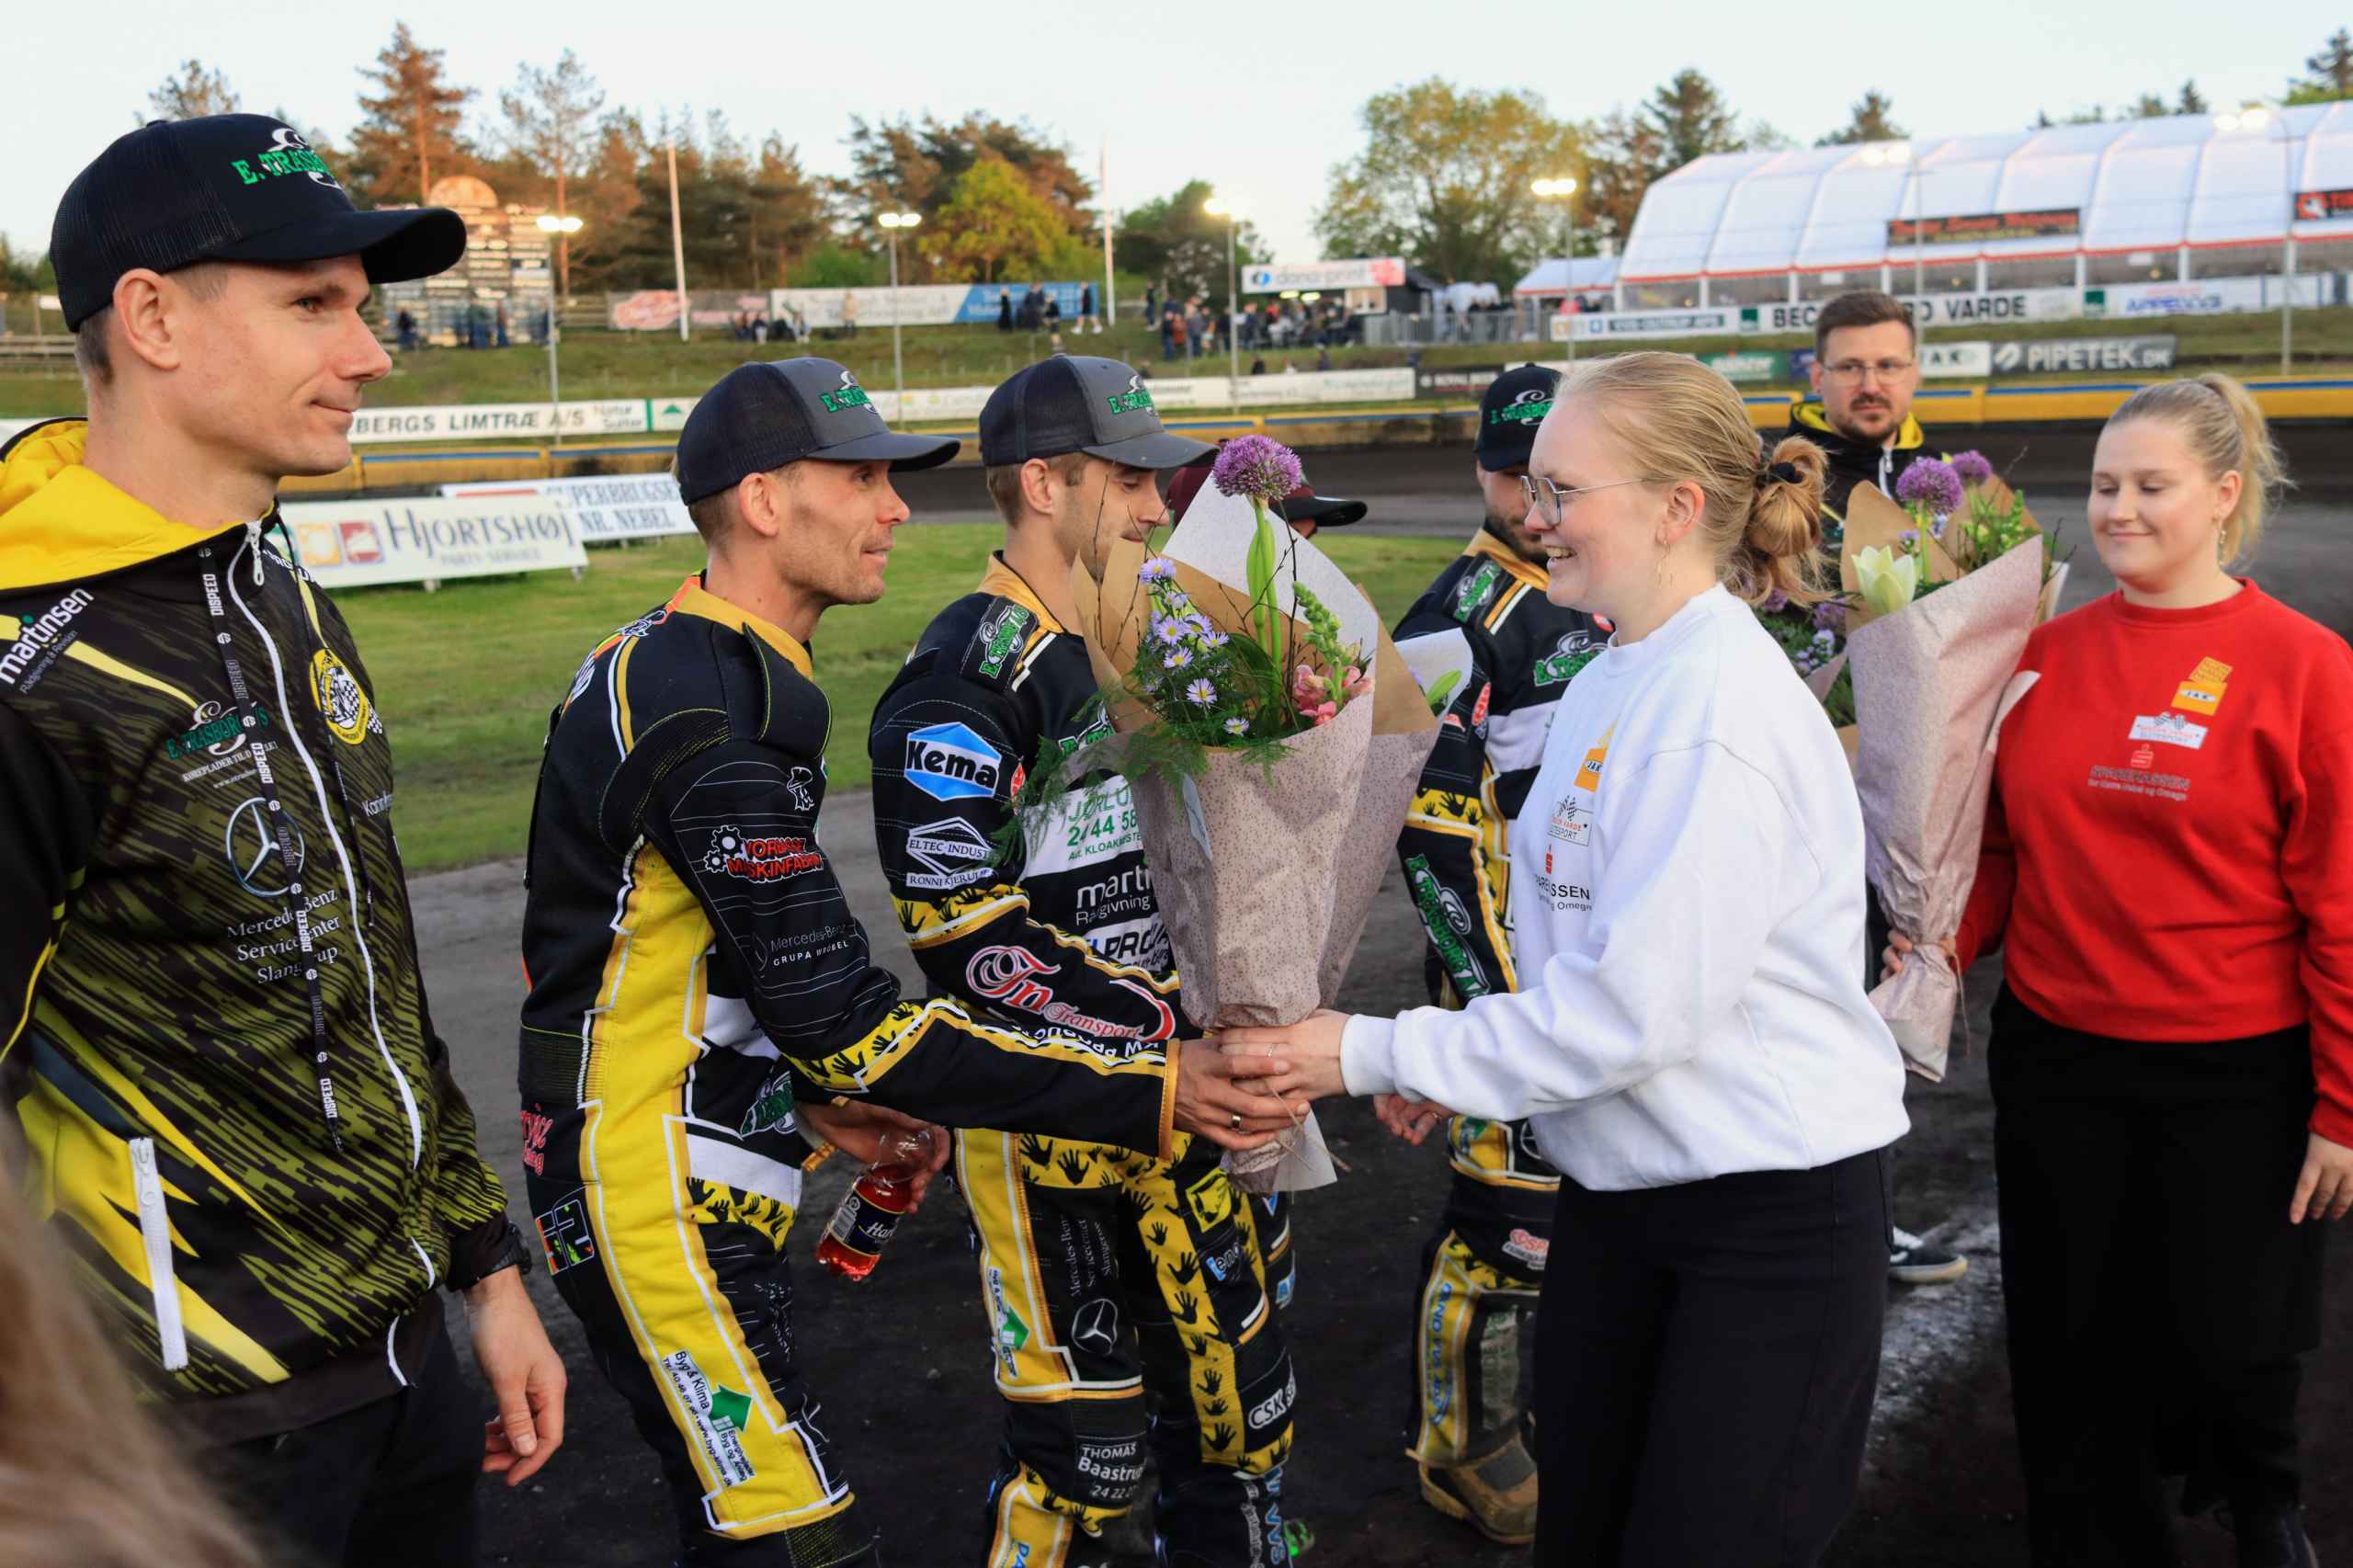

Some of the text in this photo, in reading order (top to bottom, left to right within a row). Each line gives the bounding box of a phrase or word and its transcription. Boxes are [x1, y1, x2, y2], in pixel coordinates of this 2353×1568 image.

[355, 415, 437, 434] BERGS
[203, 574, 224, 616] DISPEED
[0, 588, 95, 685] martinsen
[250, 743, 274, 784] DISPEED
[906, 741, 998, 790] Kema
[949, 844, 992, 858] INDUST
[1086, 832, 1142, 856] KLOAKMESTE
[297, 910, 313, 952] DISPEED
[773, 950, 813, 966] GRUPA
[1042, 1001, 1145, 1040] Transport
[320, 1077, 338, 1119] DISPEED
[1061, 1220, 1082, 1297] Mercedes-Ben
[676, 1350, 689, 1372] Byg
[692, 1377, 710, 1410] Klima
[1250, 1386, 1285, 1426] CSK
[1082, 1442, 1137, 1460] THOMAS
